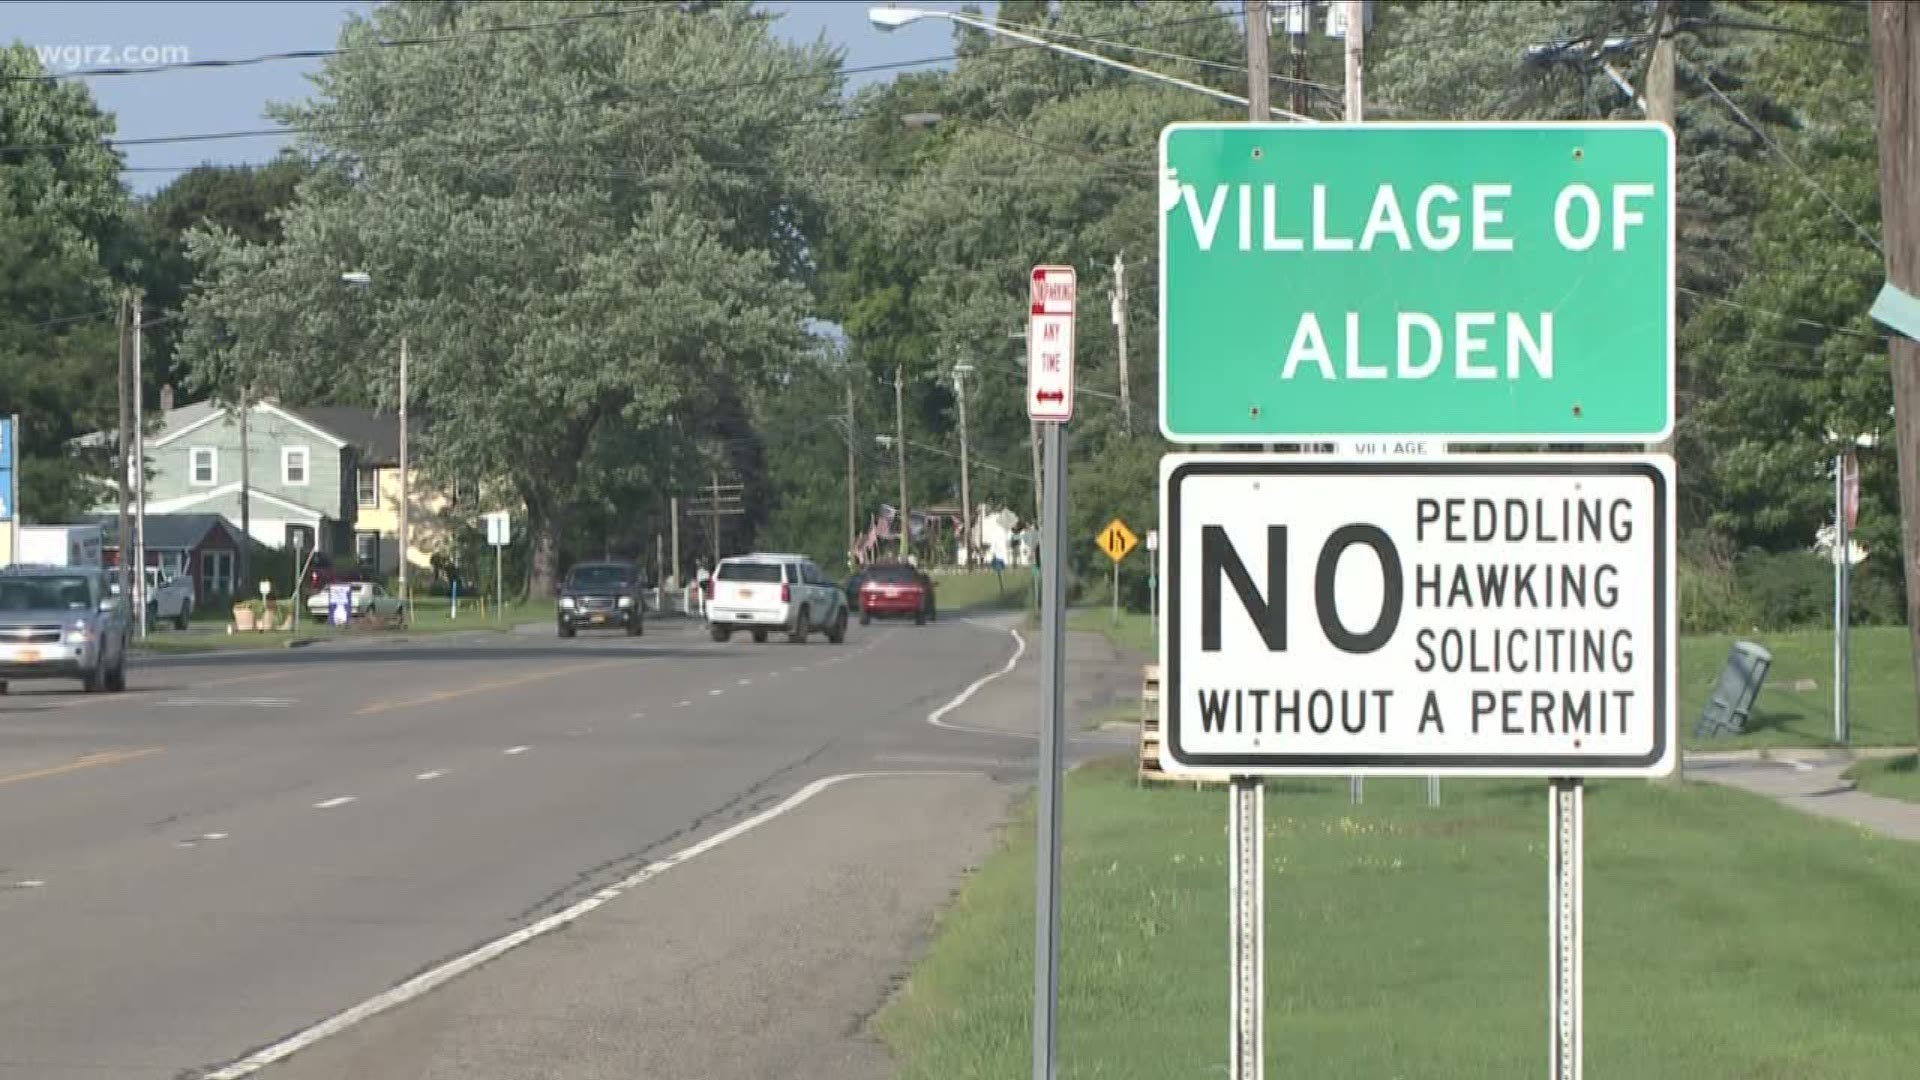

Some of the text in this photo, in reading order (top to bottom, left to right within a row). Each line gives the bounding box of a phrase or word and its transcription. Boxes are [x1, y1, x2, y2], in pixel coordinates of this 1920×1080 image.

[1181, 183, 1655, 252] VILLAGE OF
[1043, 323, 1061, 341] ANY
[1281, 311, 1554, 380] ALDEN
[1041, 353, 1061, 373] TIME
[1416, 498, 1634, 542] PEDDLING
[1200, 521, 1404, 655] NO
[1415, 563, 1619, 608] HAWKING
[1414, 628, 1634, 674] SOLICITING
[1197, 689, 1635, 734] WITHOUT A PERMIT
